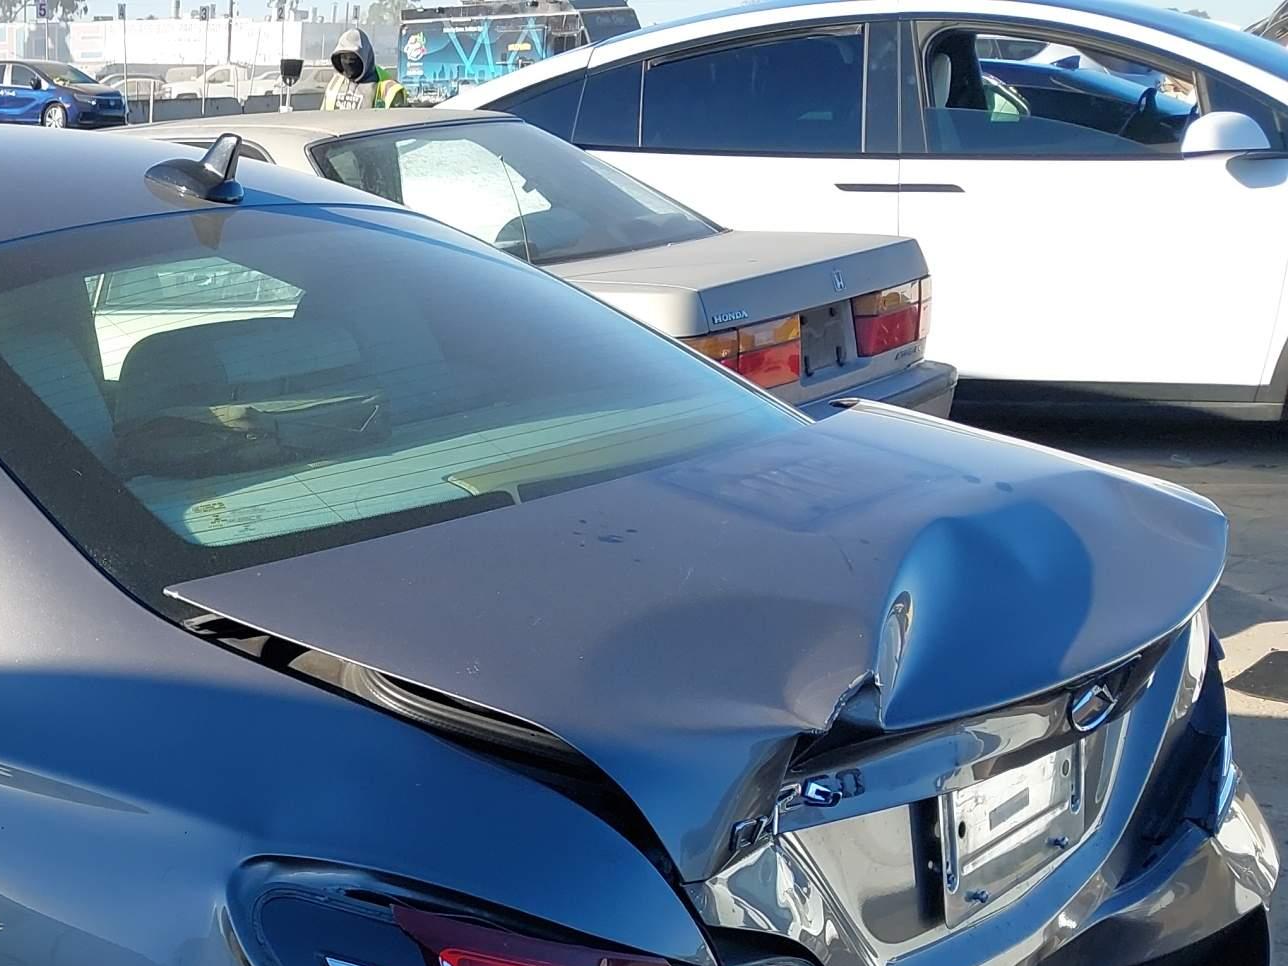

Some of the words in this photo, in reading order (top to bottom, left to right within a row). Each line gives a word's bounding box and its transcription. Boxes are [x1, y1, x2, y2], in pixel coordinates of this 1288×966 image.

[39, 3, 47, 17] 5
[201, 7, 208, 20] 3
[277, 7, 284, 19] 2
[712, 310, 749, 324] HONDA
